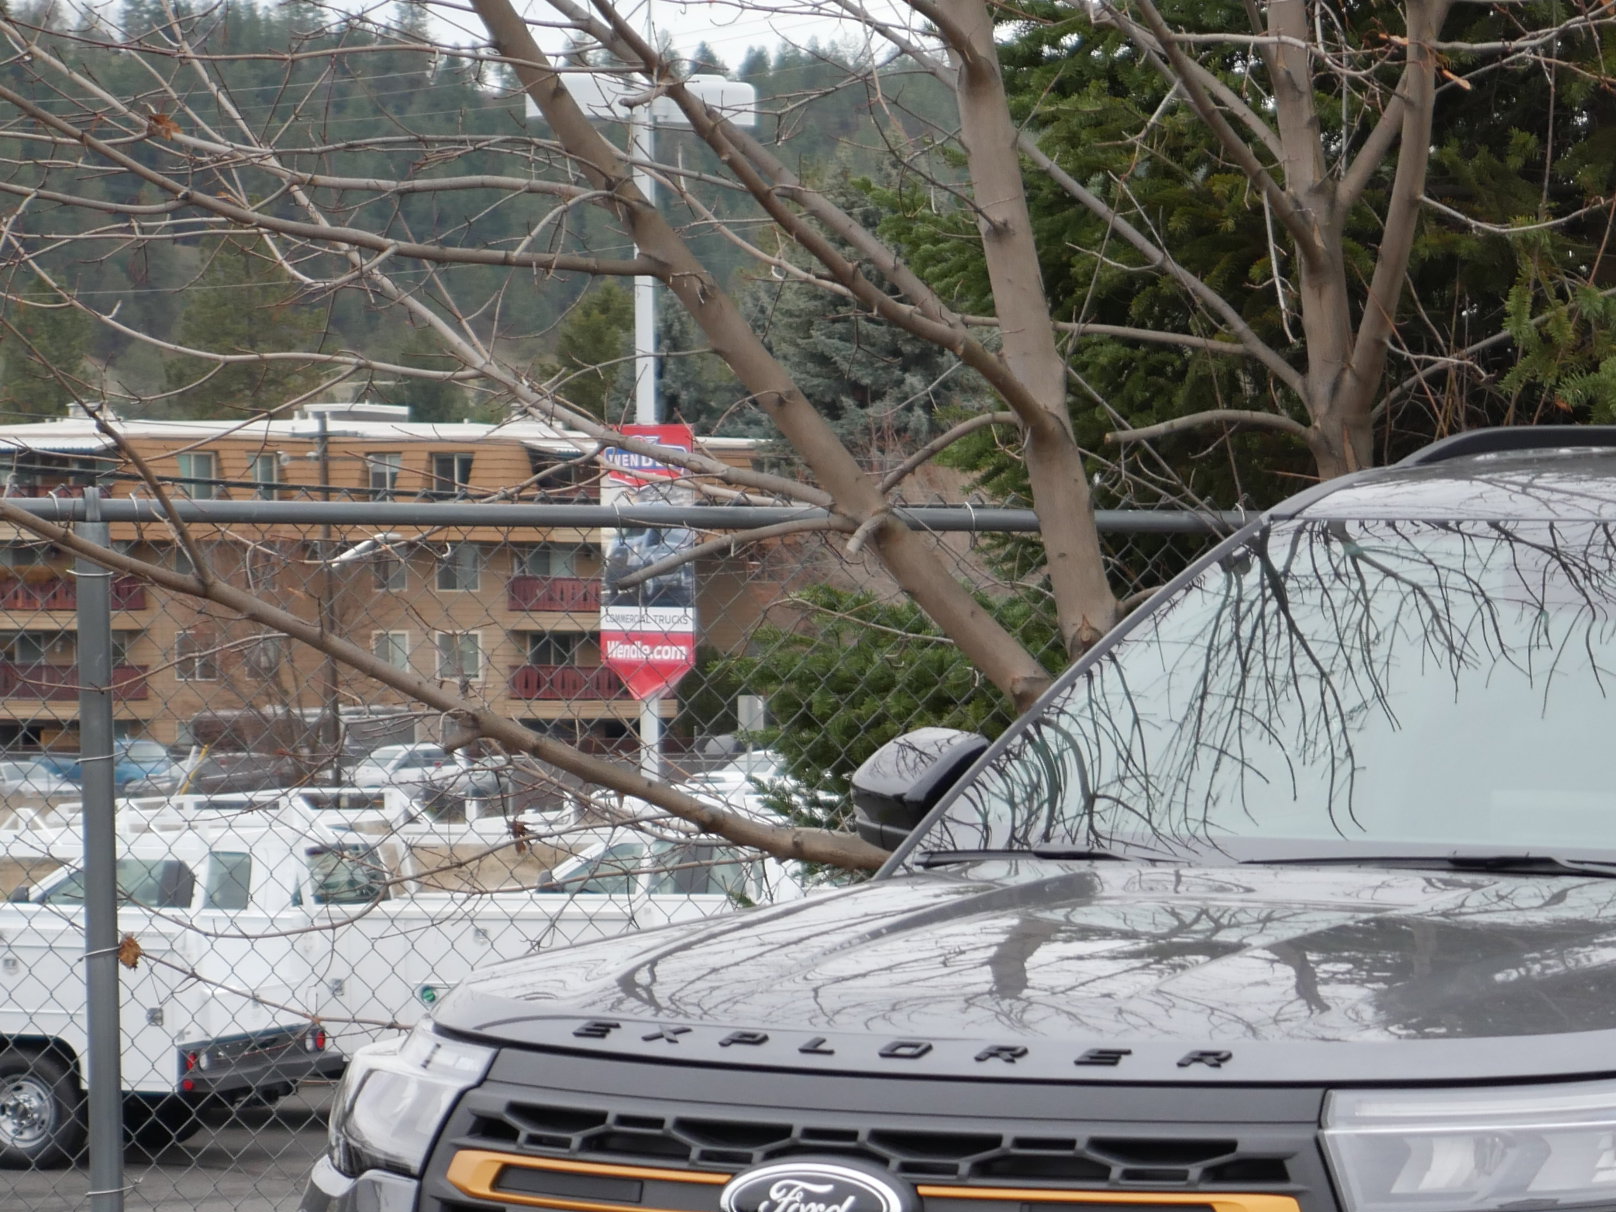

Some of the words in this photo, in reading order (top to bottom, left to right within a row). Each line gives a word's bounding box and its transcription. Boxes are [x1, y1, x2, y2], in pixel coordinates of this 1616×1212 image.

[608, 453, 680, 469] WEND
[653, 614, 688, 625] TRUCKS
[606, 640, 687, 660] Wendle.com
[572, 1020, 1233, 1069] EXPLORER
